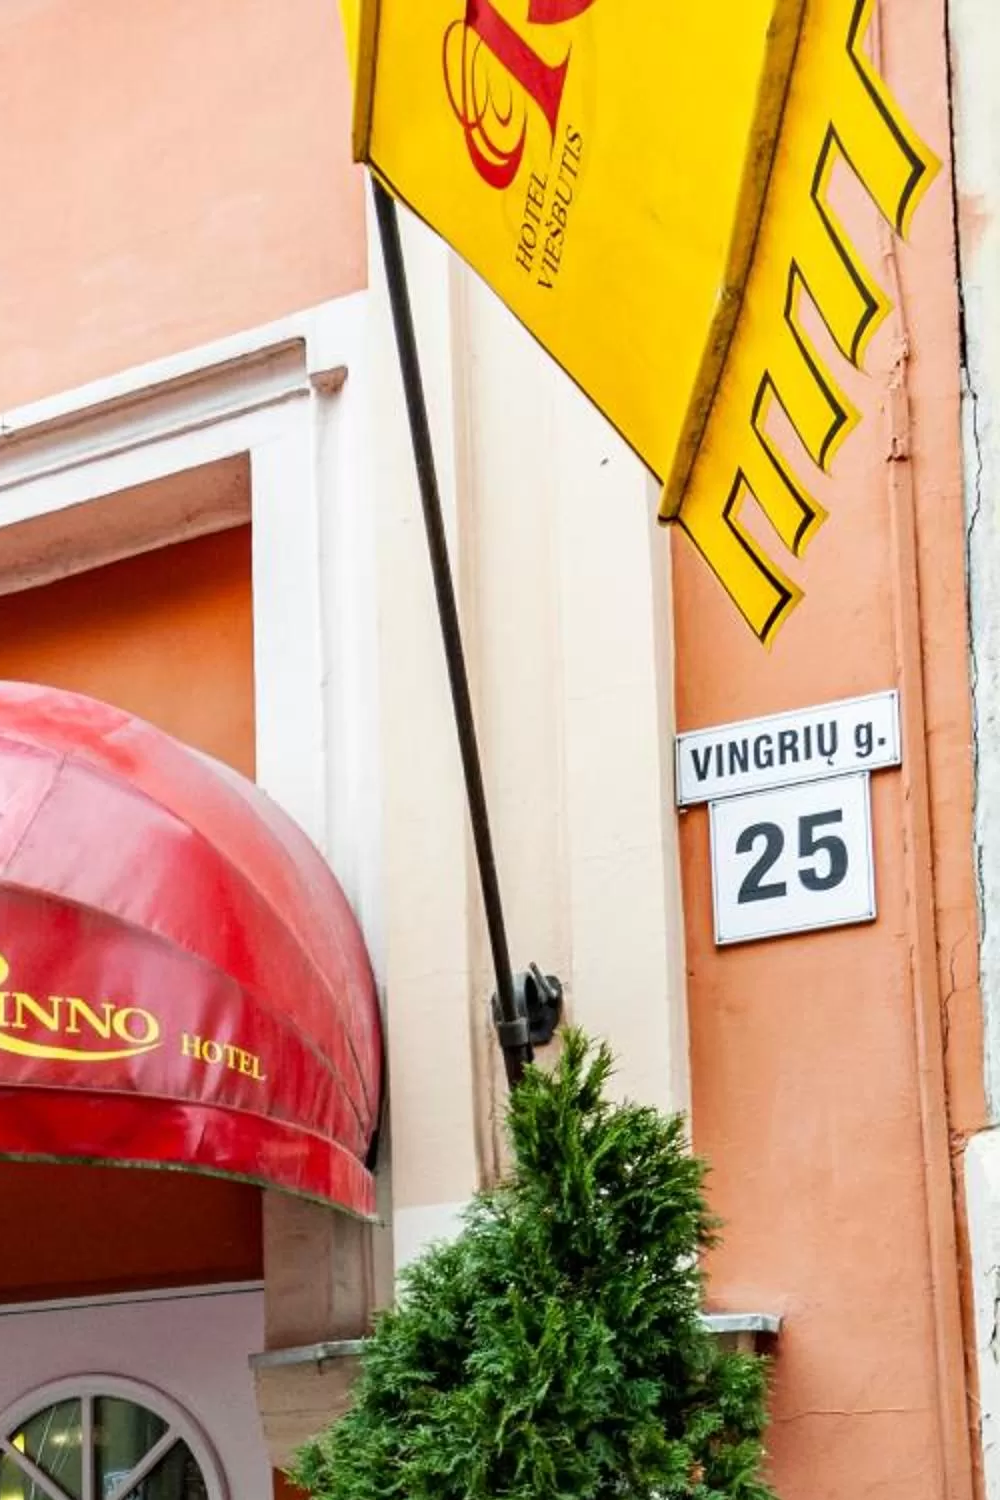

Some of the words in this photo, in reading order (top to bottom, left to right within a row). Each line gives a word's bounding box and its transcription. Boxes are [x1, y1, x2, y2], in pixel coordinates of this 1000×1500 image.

[516, 171, 548, 272] HOTEL
[537, 125, 583, 289] VIEŠBUTIS
[690, 720, 838, 782] VINGRIŲ
[855, 721, 887, 758] g.
[735, 808, 849, 904] 25
[181, 1034, 268, 1081] HOTEL
